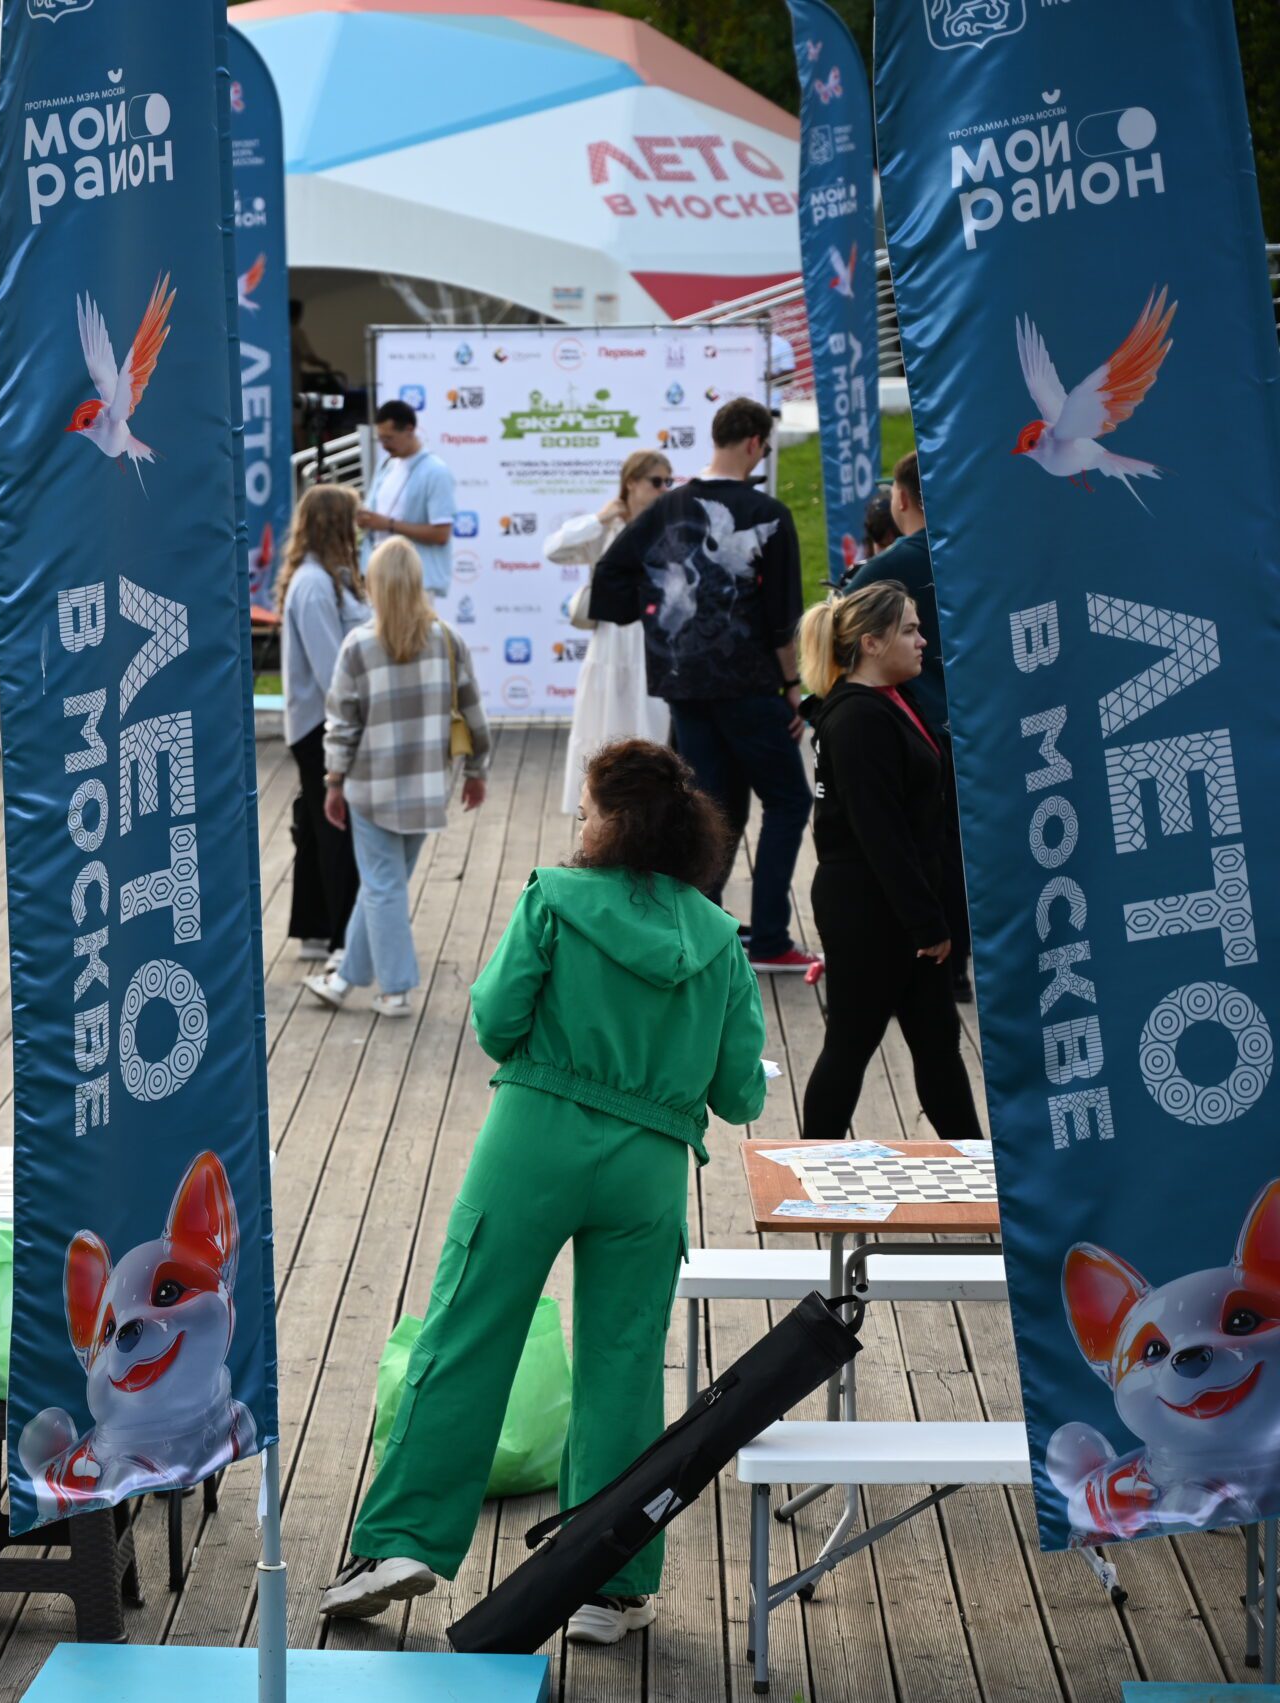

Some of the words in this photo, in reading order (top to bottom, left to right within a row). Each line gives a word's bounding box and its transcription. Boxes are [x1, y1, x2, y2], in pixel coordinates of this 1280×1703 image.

[25, 95, 74, 111] ПРОГРАММА
[76, 92, 100, 103] МЭРА
[101, 86, 126, 99] МОСКВЫ
[948, 118, 1010, 141] ПРОГРАММА
[1011, 112, 1035, 126] МЭРА
[1036, 105, 1067, 120] МОСКВЫ
[587, 135, 785, 186] ЛЕТО
[603, 193, 638, 217] В
[645, 192, 799, 220] МОСКВ
[598, 347, 647, 360] Первые
[239, 340, 272, 506] ЛЕТО
[441, 433, 489, 446] Первые
[832, 364, 855, 505] МОСКВЕ
[848, 331, 873, 499] ЛЕТО
[493, 559, 542, 572] Первые
[57, 581, 106, 653] В
[1009, 600, 1060, 674] В
[119, 574, 209, 1102] ЛЕТО
[1086, 591, 1274, 1126] ЛЕТО
[63, 687, 110, 1138] МОСКВЕ
[1020, 704, 1116, 1151] МОСКВЕ
